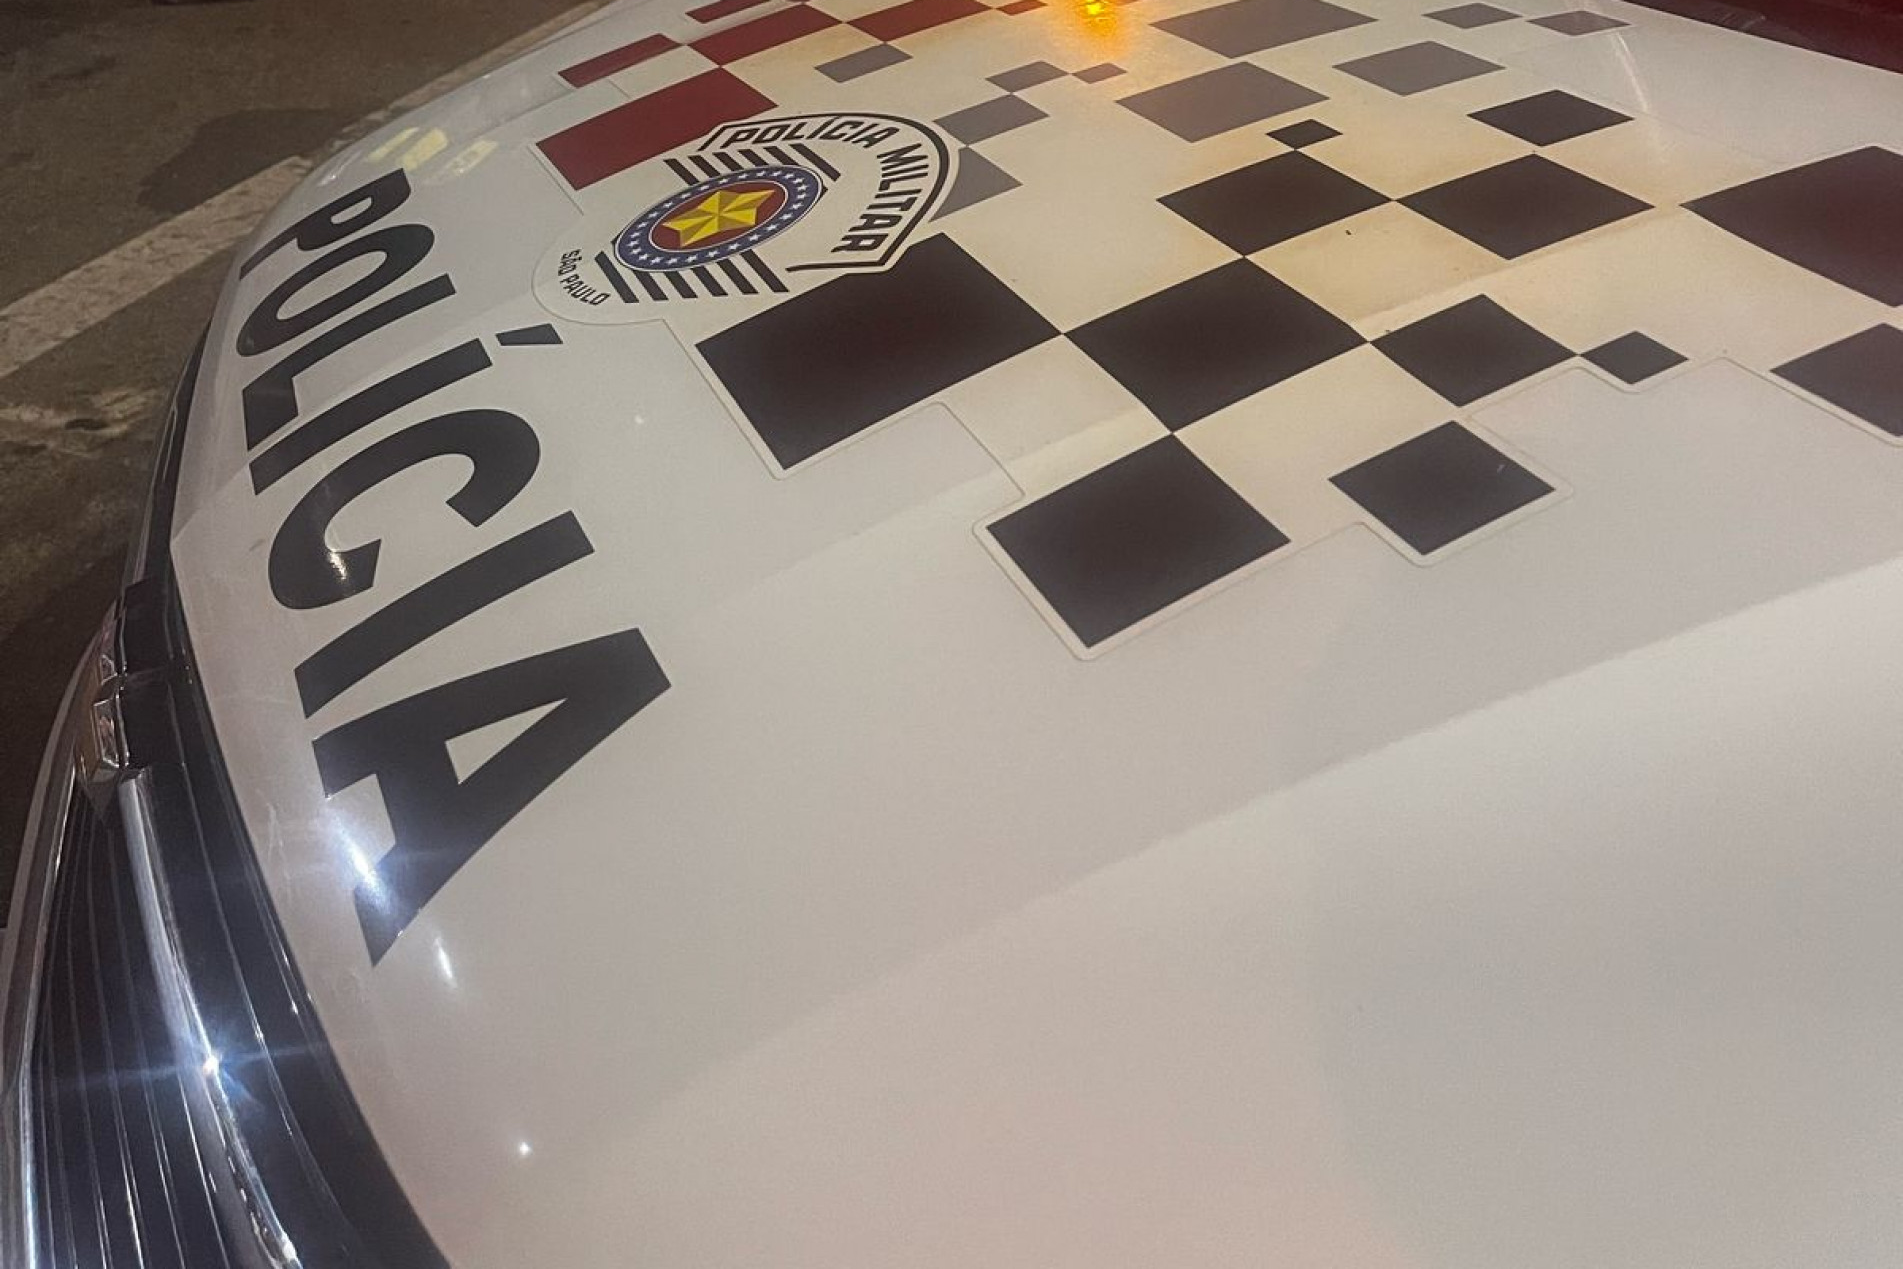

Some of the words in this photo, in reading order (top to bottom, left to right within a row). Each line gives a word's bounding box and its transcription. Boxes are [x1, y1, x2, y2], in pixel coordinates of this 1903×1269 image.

[722, 115, 902, 148] POLÍCIA
[830, 142, 930, 253] MILITAR
[557, 248, 582, 276] SÃO
[559, 274, 611, 306] PAULO
[235, 166, 672, 969] POLÍCIA
